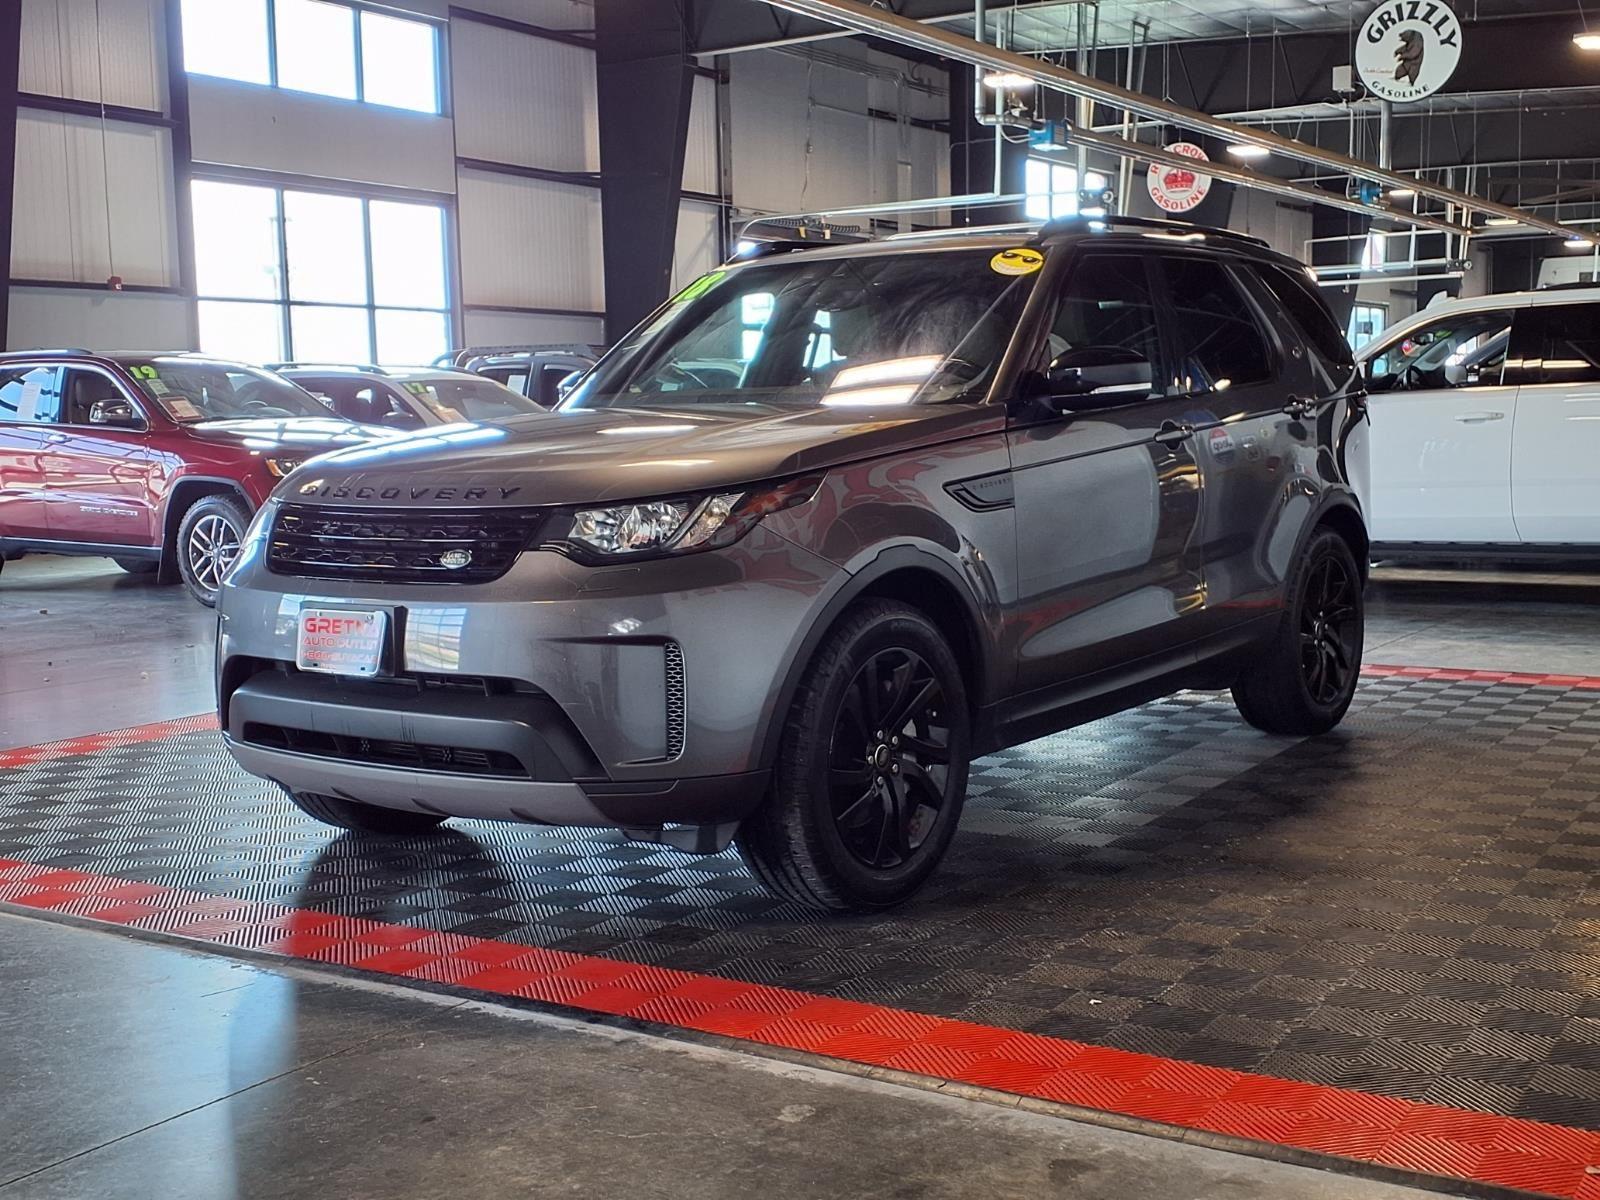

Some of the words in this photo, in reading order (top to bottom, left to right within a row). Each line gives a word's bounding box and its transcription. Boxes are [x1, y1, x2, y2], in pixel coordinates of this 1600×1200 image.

[1367, 1, 1457, 48] GRIZZLY
[1371, 81, 1430, 98] GASOLINE
[1173, 144, 1207, 160] CROW
[1151, 186, 1206, 210] GASOLINE
[130, 365, 156, 379] 19
[299, 486, 521, 501] DISCOVERY
[303, 636, 335, 647] AUTO
